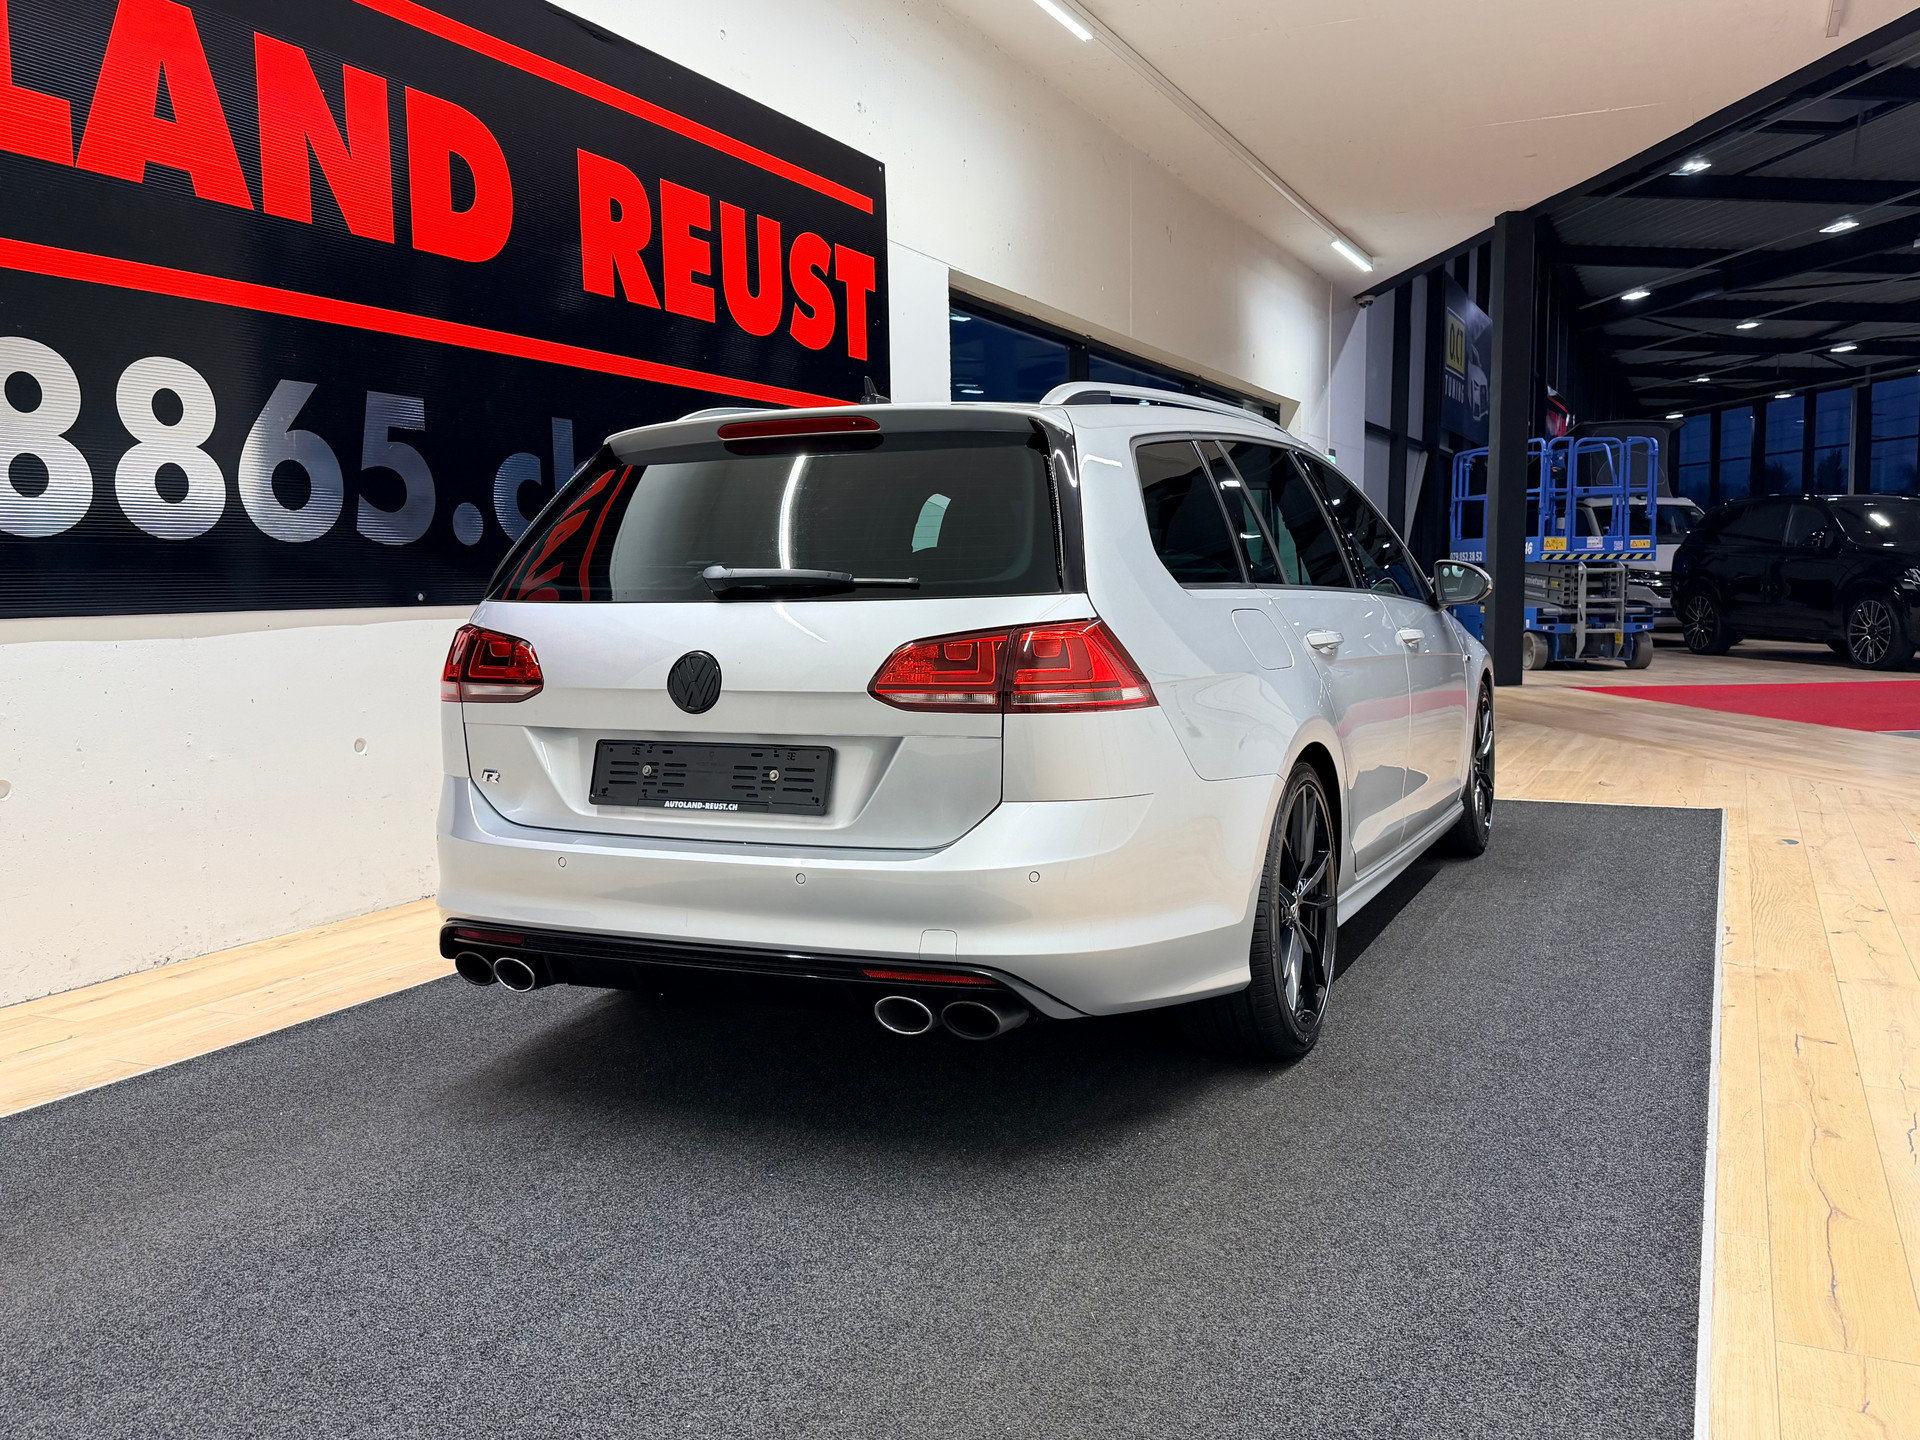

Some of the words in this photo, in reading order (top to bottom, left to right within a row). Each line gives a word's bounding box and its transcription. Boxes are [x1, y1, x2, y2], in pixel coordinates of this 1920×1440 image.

[576, 147, 876, 361] REUST
[1476, 551, 1483, 562] 52
[481, 769, 500, 785] R
[664, 800, 738, 811] AUTOLAND-REUST.CH
